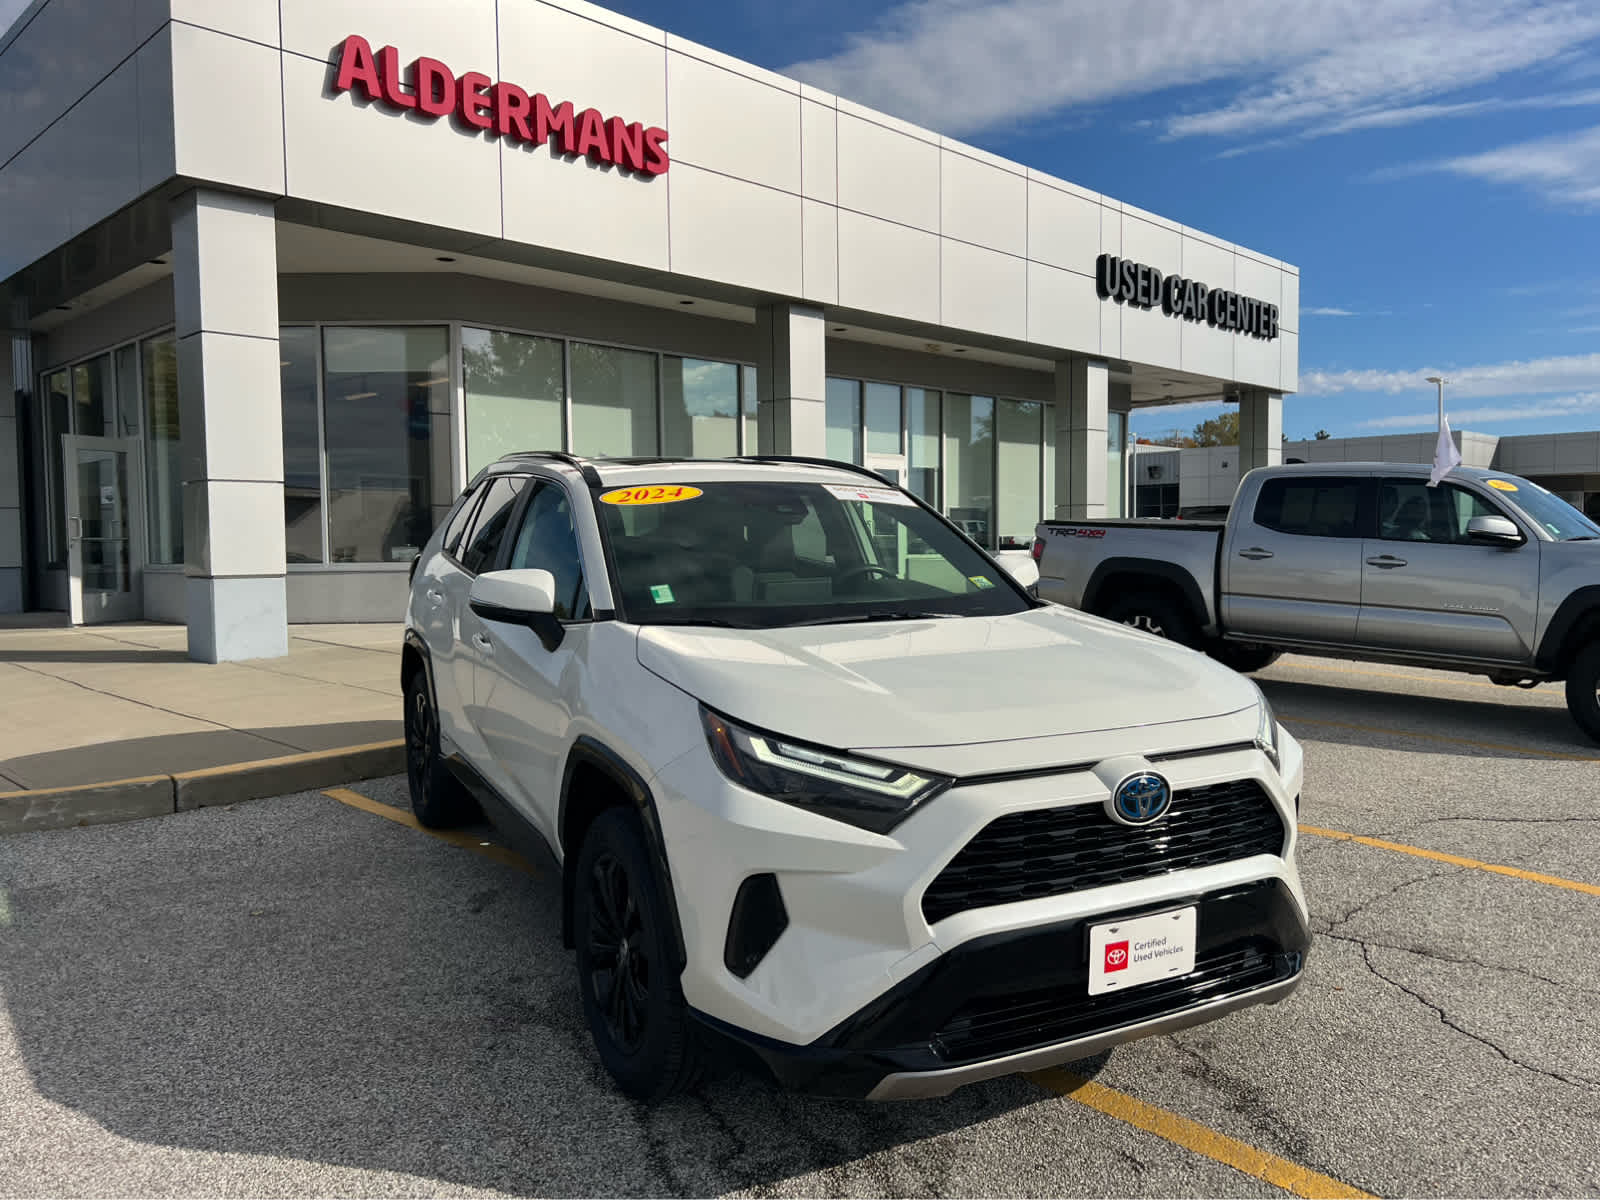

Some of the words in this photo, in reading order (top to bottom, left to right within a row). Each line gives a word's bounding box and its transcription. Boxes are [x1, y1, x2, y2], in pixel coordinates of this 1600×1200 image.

[332, 34, 670, 175] ALDERMANS
[1099, 253, 1164, 309] USED
[1166, 274, 1210, 320] CAR
[1212, 287, 1280, 339] CENTER
[618, 487, 684, 503] 2024
[1134, 937, 1167, 950] Certified
[1133, 951, 1153, 962] Used
[1154, 945, 1183, 958] Vehicles
